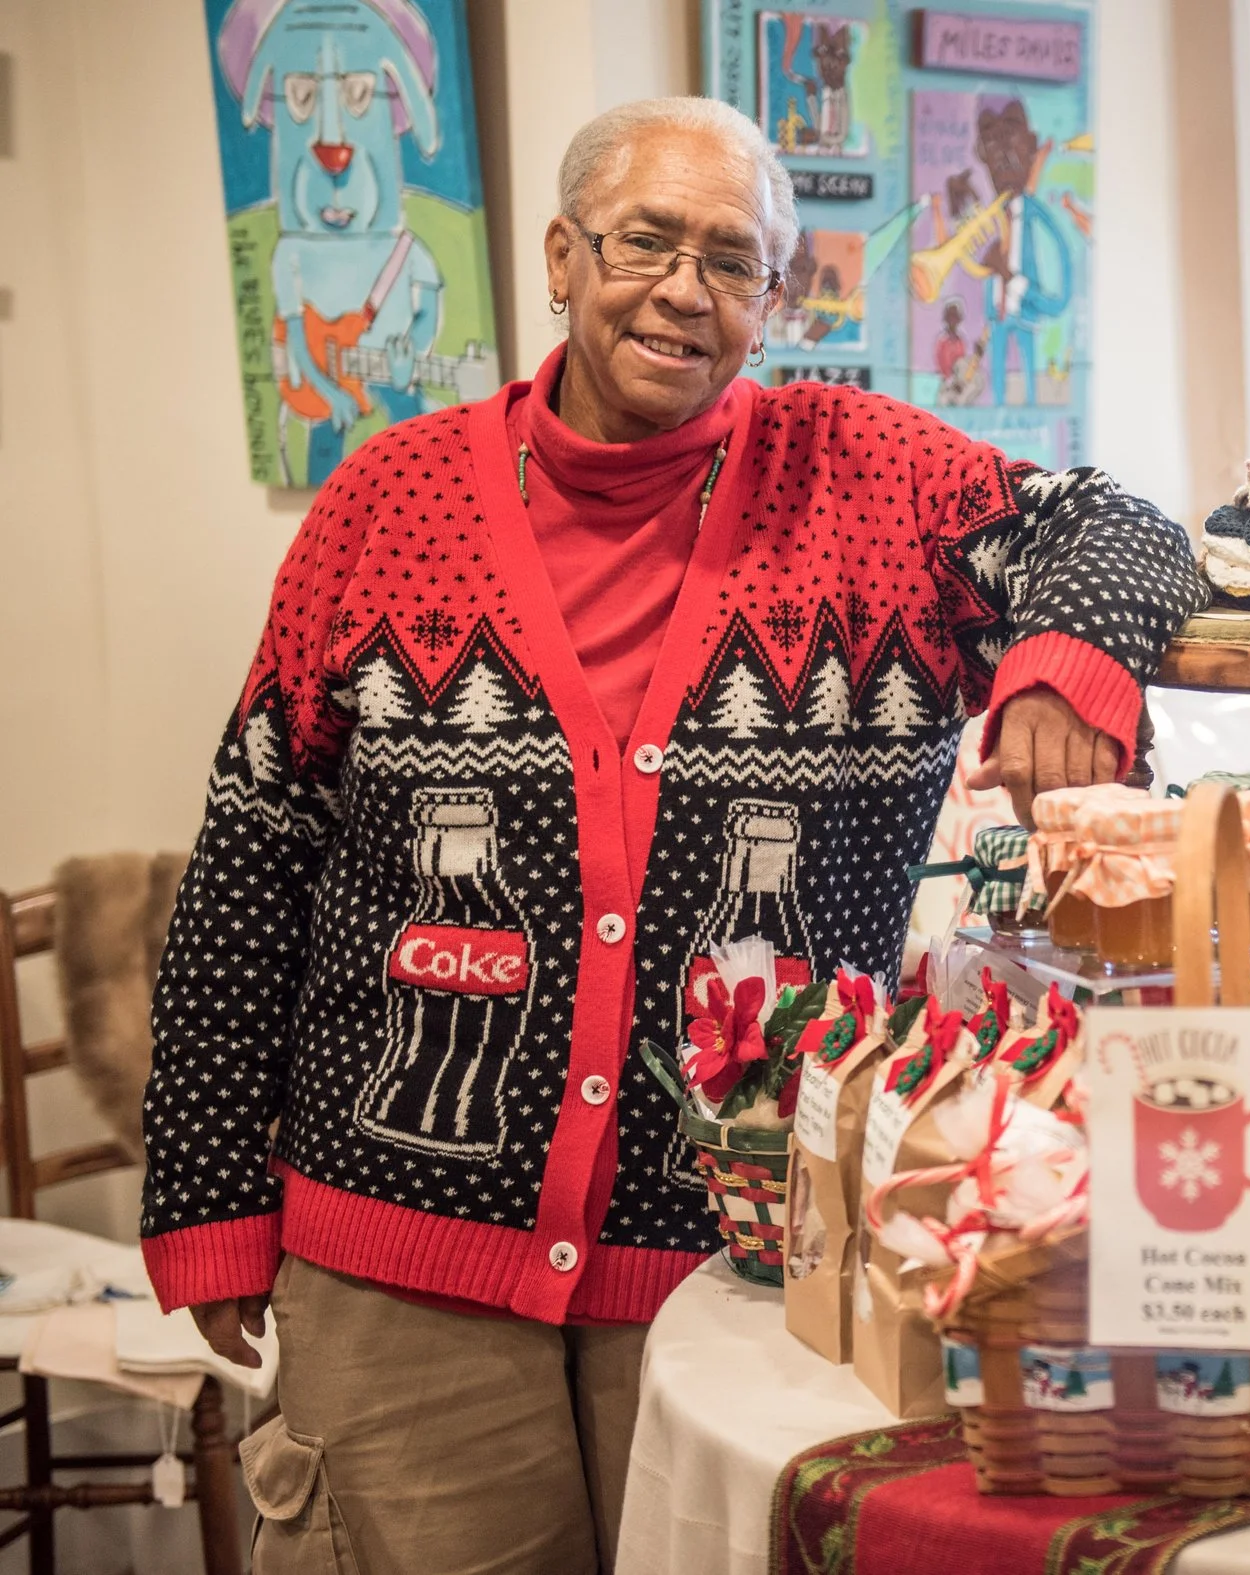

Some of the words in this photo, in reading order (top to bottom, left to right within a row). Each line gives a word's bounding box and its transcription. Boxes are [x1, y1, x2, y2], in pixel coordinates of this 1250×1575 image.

[937, 29, 1014, 66] MILES
[399, 937, 524, 984] Coke
[1140, 1247, 1179, 1267] Hot
[1184, 1247, 1246, 1268] Cocoa
[1202, 1275, 1242, 1296] Mix
[1200, 1304, 1246, 1324] each
